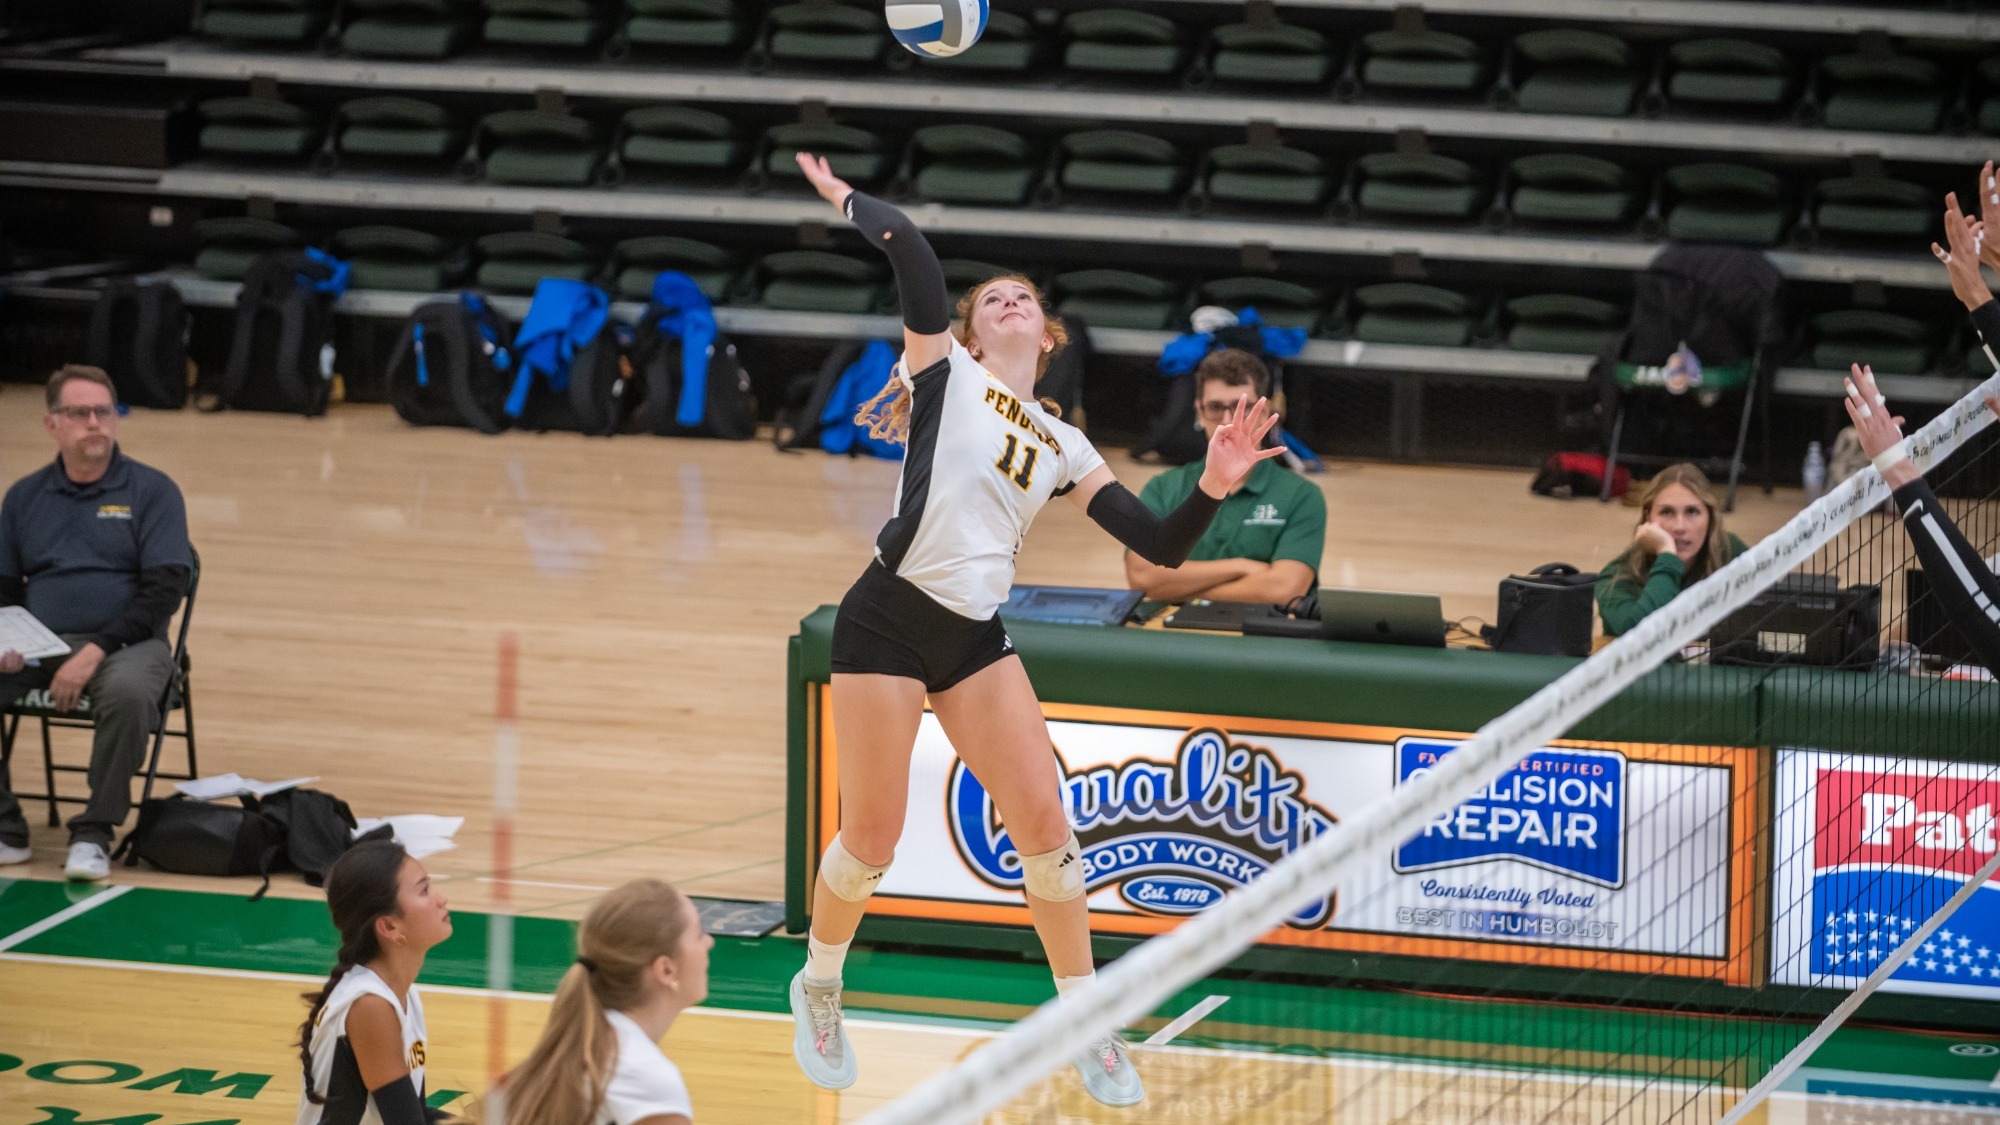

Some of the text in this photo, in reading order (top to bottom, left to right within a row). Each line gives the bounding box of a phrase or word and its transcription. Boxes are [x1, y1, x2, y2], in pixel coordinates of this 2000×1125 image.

[994, 432, 1039, 493] 11
[14, 688, 91, 711] ACS
[1407, 767, 1613, 808] LISION
[1423, 804, 1598, 849] REPAIR
[1082, 841, 1269, 884] BODY WORK
[1138, 883, 1211, 903] Est. 1978
[1420, 879, 1596, 909] Consistently Voted
[1396, 906, 1619, 940] BEST IN HUMBOLDT
